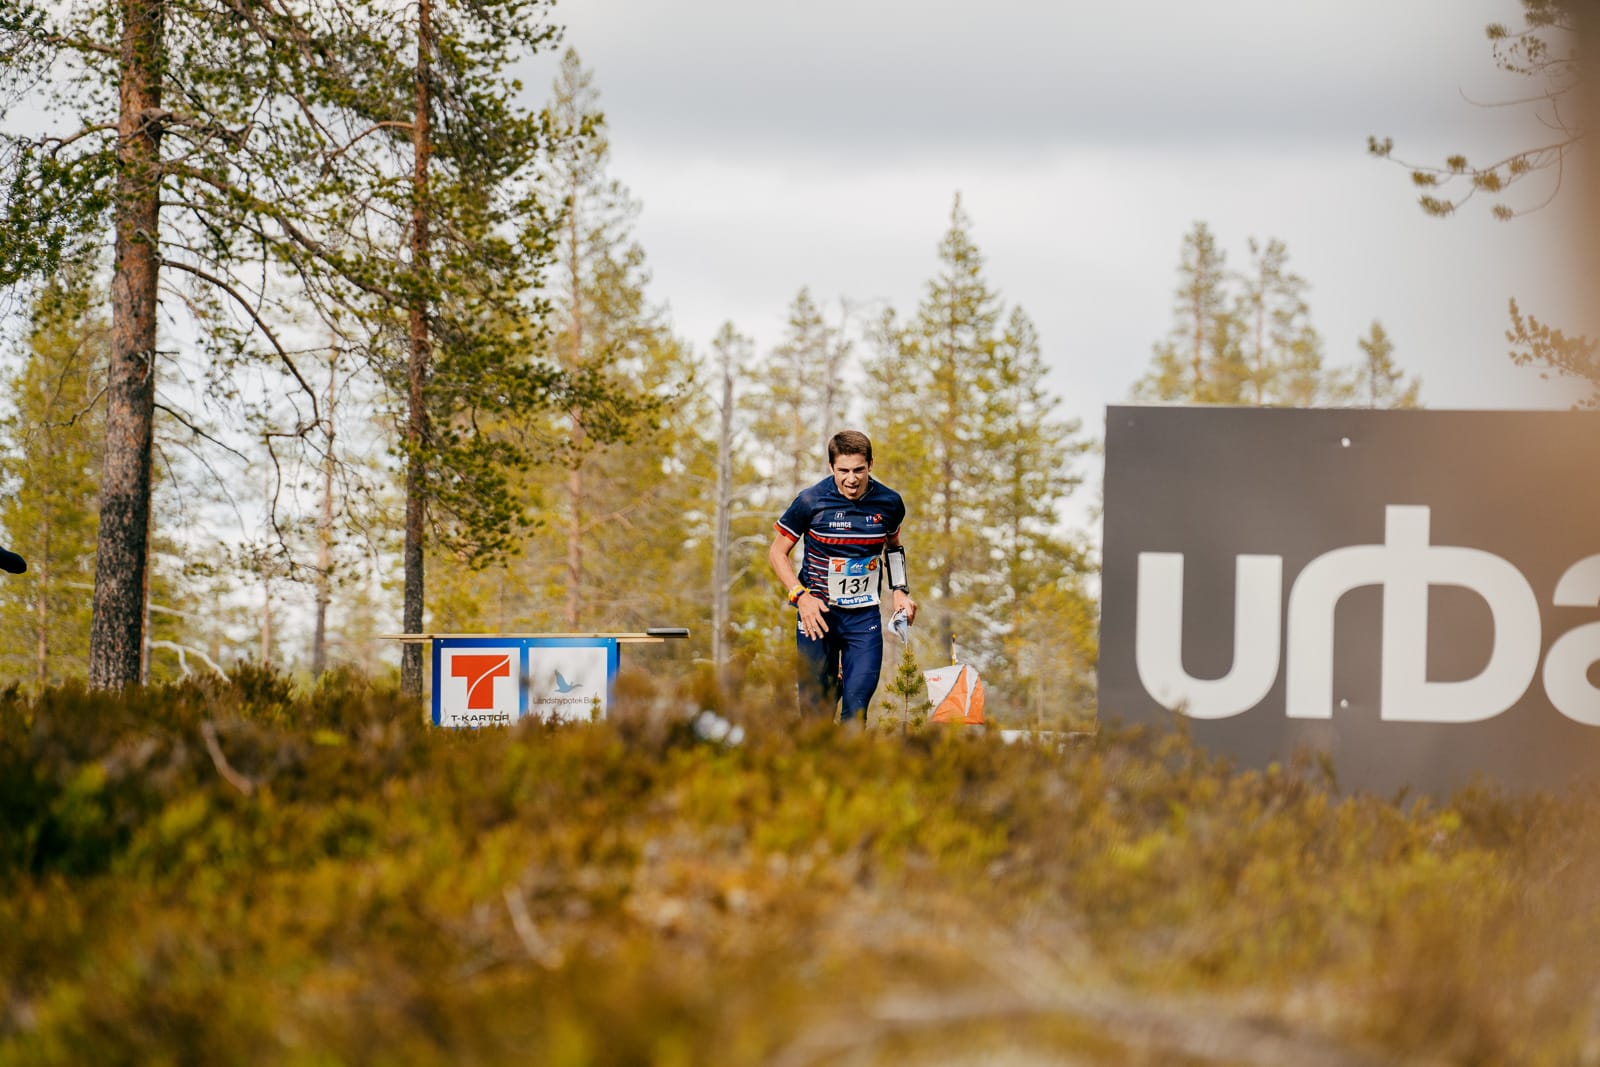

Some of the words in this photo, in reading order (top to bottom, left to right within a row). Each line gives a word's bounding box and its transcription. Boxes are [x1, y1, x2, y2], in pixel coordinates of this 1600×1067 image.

[838, 577, 869, 594] 131
[1136, 505, 1600, 727] urba
[533, 696, 583, 705] Landshypotek
